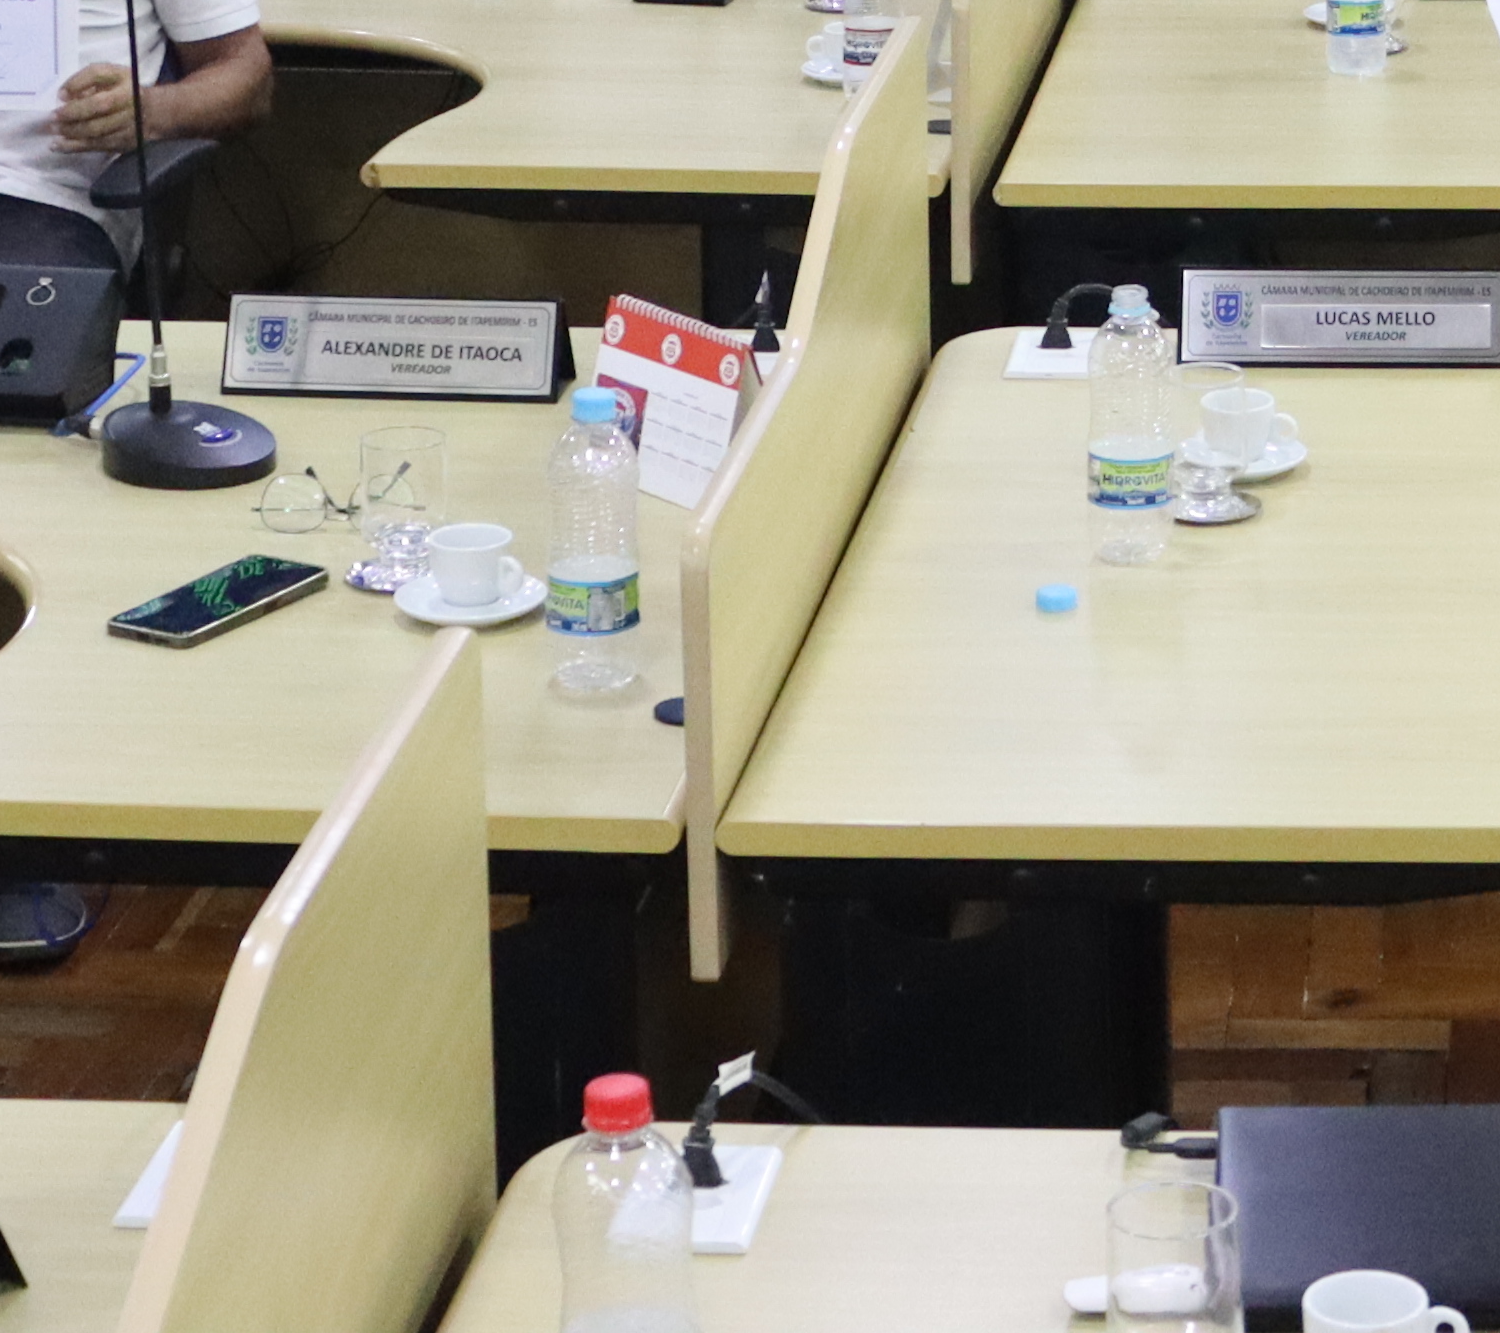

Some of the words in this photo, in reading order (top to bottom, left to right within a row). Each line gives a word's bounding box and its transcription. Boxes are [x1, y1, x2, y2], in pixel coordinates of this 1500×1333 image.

[1316, 311, 1371, 326] LUCAS
[1377, 311, 1435, 326] MELLO
[1345, 331, 1406, 341] VEREADOR
[322, 340, 425, 358] ALEXANDRE
[431, 342, 453, 359] DE
[459, 344, 522, 362] ITAOCA
[391, 363, 451, 374] VEREADOR
